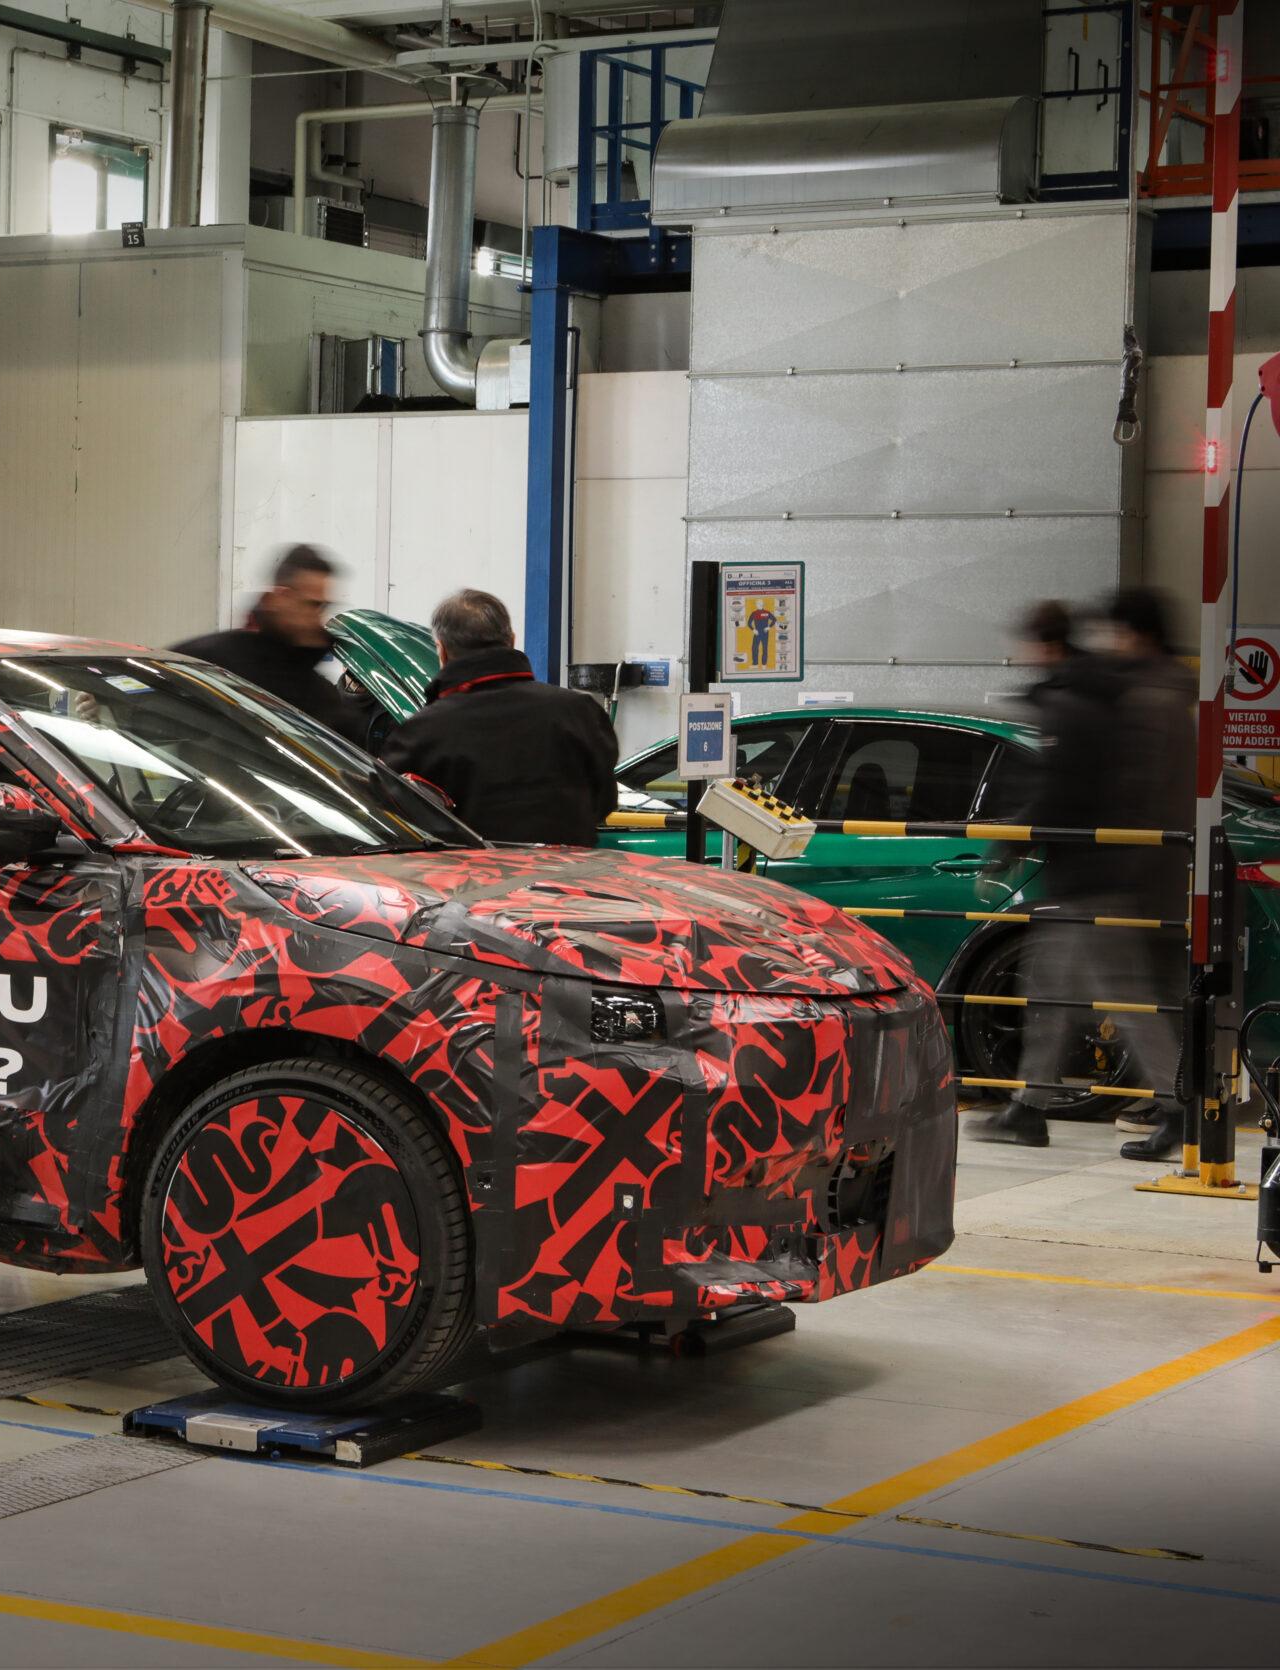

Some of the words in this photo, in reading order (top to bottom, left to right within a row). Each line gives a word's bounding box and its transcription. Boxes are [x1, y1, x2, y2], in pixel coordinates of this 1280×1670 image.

[128, 234, 140, 245] 15
[1228, 712, 1267, 722] VIETATO
[688, 721, 722, 731] POSTAZIONE
[1223, 724, 1275, 734] 'INGRESSO
[1222, 735, 1242, 745] NON
[1244, 736, 1280, 746] ADDETT
[703, 741, 708, 752] 6
[156, 1112, 200, 1178] MICHELIN
